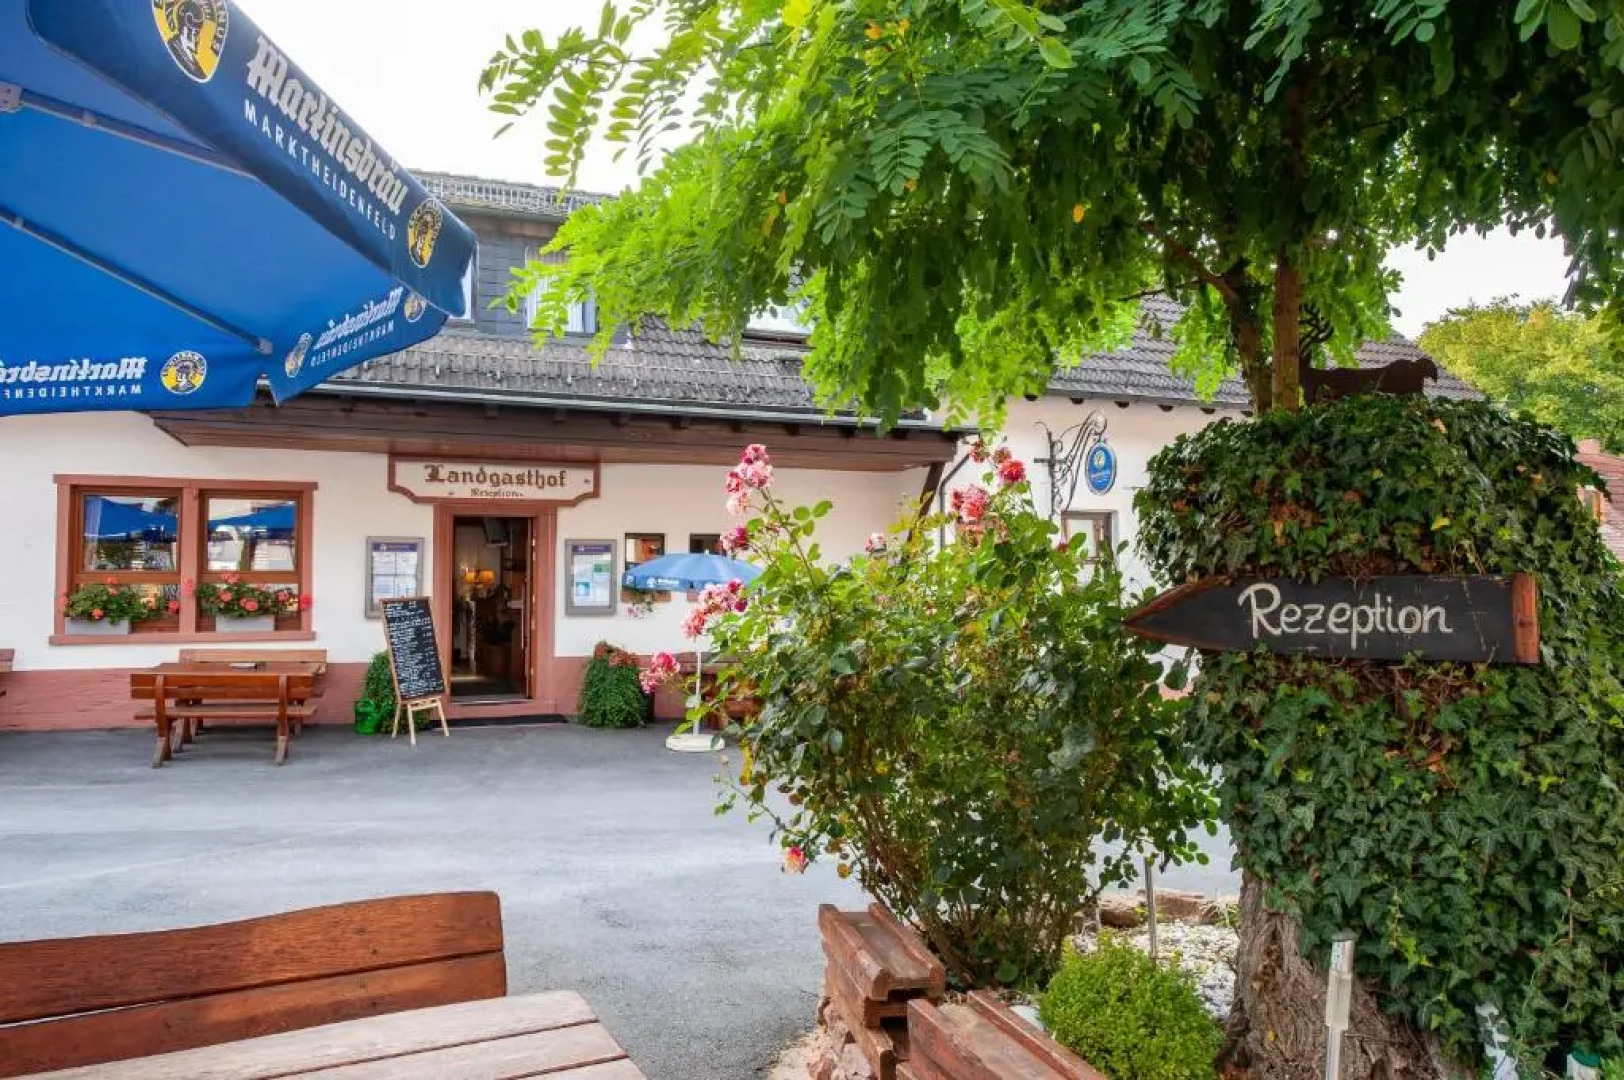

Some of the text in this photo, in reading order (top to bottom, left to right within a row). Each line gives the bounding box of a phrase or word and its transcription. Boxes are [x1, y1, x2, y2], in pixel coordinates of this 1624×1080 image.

[244, 98, 396, 240] MARKTHEIDENFELD
[246, 34, 409, 215] Martinsbräu
[424, 464, 567, 489] Landgasthof
[1237, 582, 1454, 650] Rezeption
